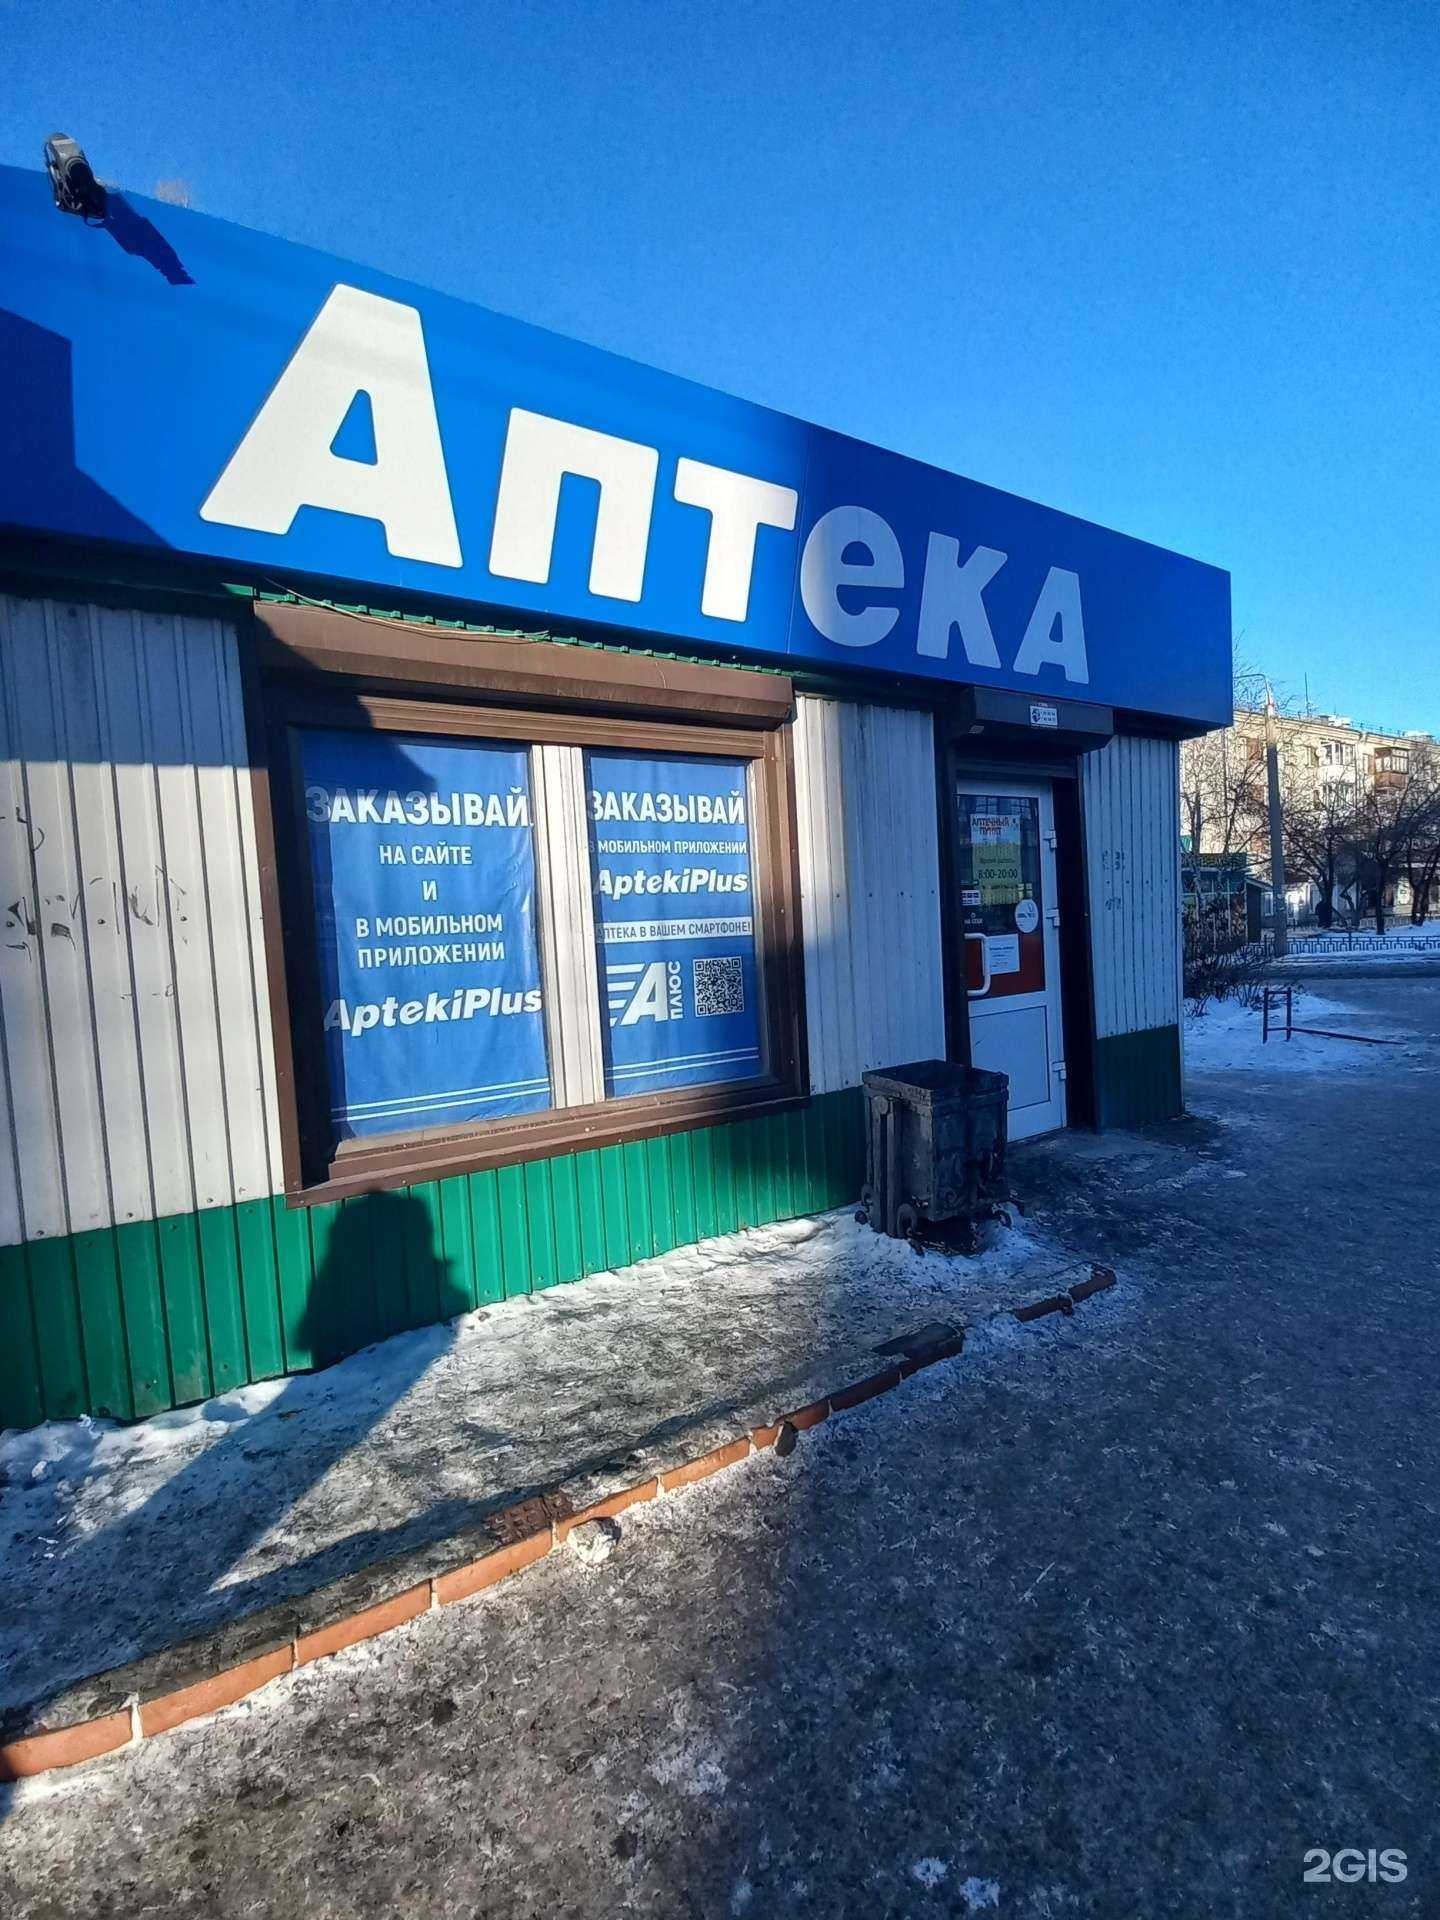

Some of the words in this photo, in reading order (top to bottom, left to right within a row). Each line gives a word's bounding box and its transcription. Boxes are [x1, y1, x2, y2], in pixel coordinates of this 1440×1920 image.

[305, 785, 530, 828] ЗАКАЗЫВАЙ
[586, 790, 745, 824] ЗАКАЗЫВАЙ
[379, 844, 407, 865] НА
[411, 841, 473, 865] САЙТЕ
[597, 840, 671, 854] МОБИЛЬНОМ
[674, 841, 748, 854] ПРИЛОЖЕНИИ
[422, 880, 438, 901] И
[592, 868, 749, 901] AptekiPlus
[355, 918, 370, 938] В
[375, 913, 503, 937] МОБИЛЬНОМ
[640, 926, 647, 938] В
[649, 924, 686, 937] ВАШЕМ
[688, 920, 751, 935] СМАРТФОНЕ!
[358, 941, 505, 969] ПРИЛОЖЕНИИ
[668, 960, 684, 1020] ПЛЮС
[323, 986, 543, 1037] AptekiPlus
